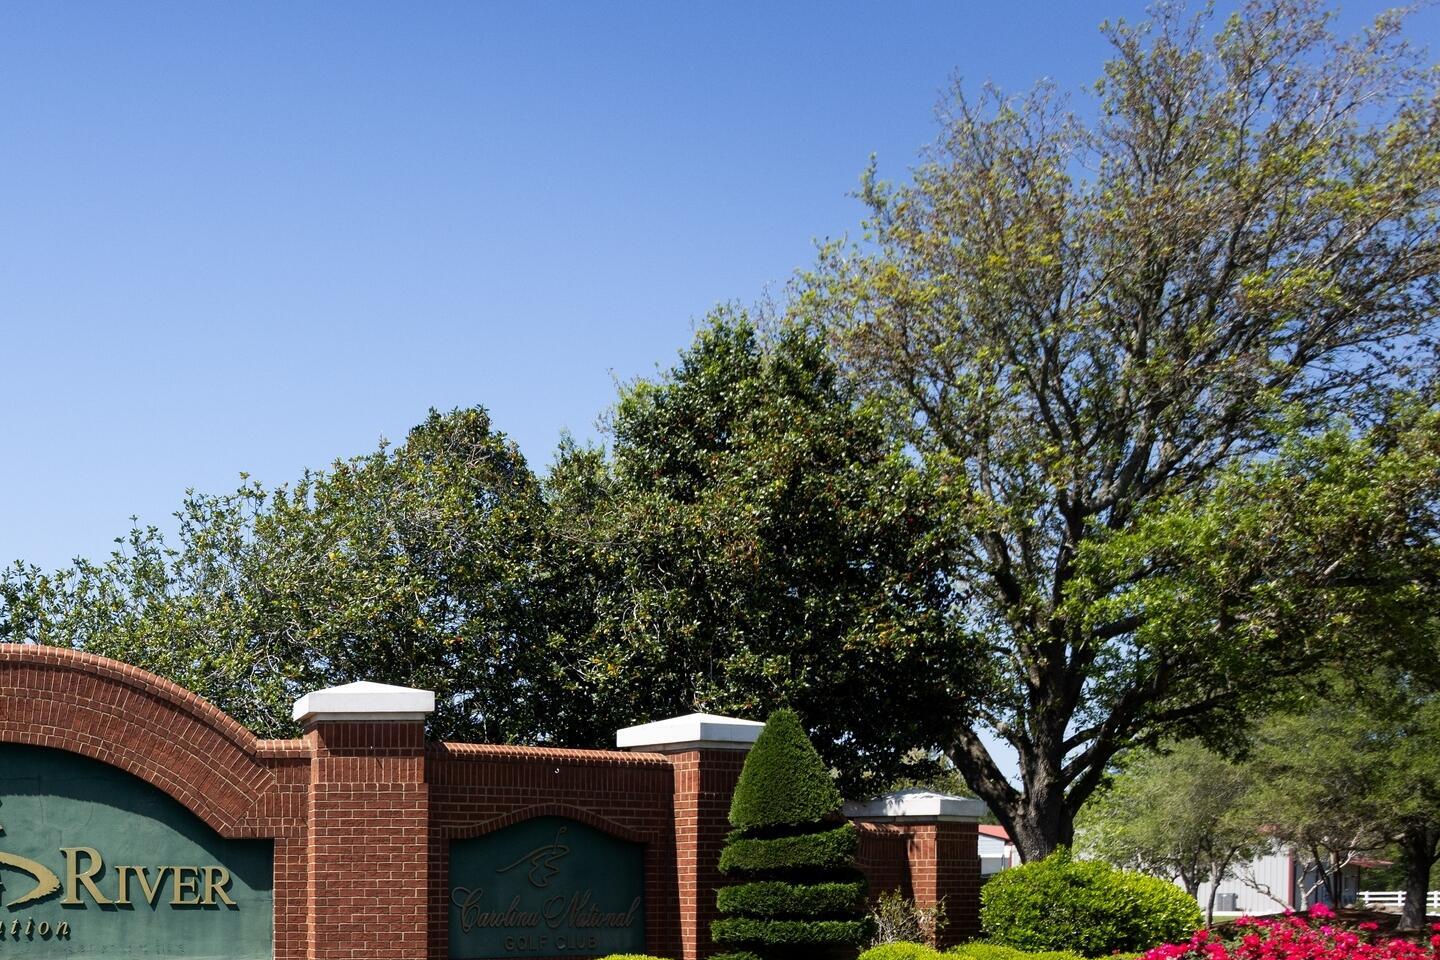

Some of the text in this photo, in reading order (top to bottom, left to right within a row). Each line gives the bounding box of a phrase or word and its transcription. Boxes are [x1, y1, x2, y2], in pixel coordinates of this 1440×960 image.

[61, 846, 237, 906] RIVER
[451, 886, 641, 933] Carolina National
[504, 935, 600, 951] GOLF CLUB
